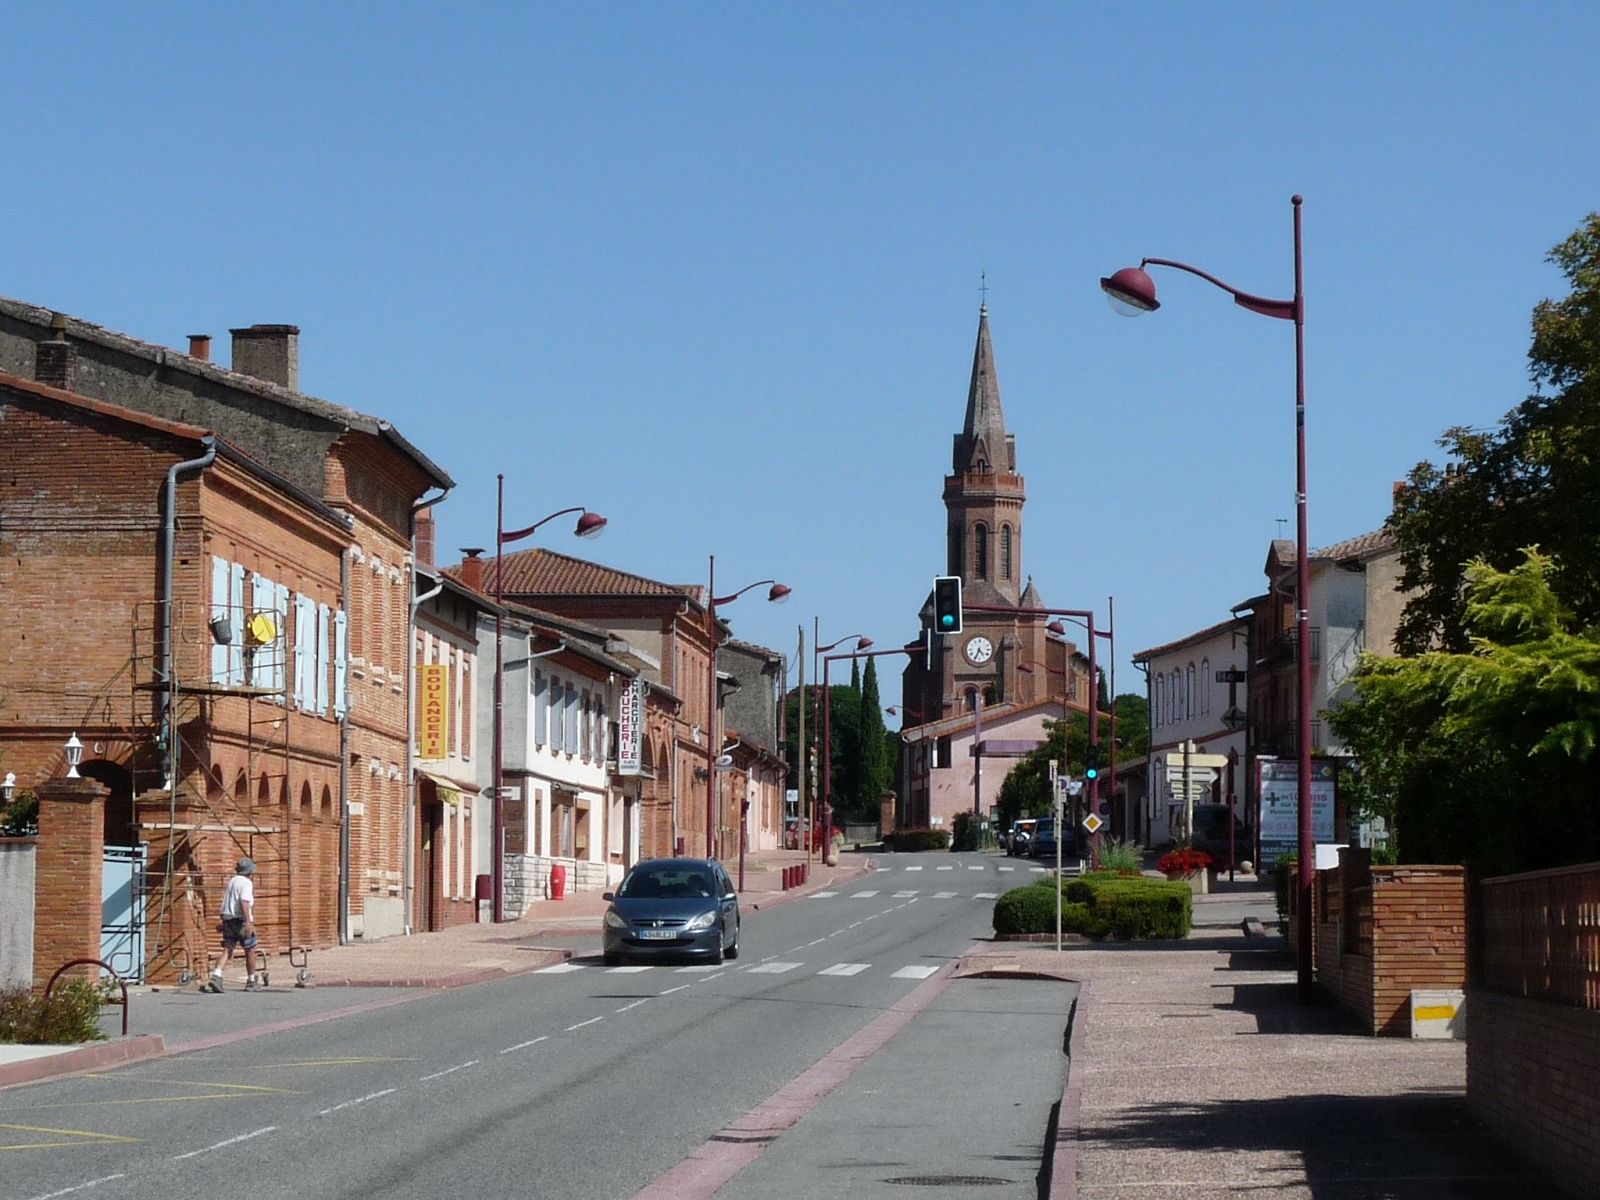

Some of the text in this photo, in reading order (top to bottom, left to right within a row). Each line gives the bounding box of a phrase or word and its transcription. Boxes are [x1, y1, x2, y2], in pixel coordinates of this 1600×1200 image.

[427, 668, 441, 755] BOULANGERIE
[621, 679, 630, 759] BOUCHERIE
[630, 679, 639, 760] CHARCUTERIE
